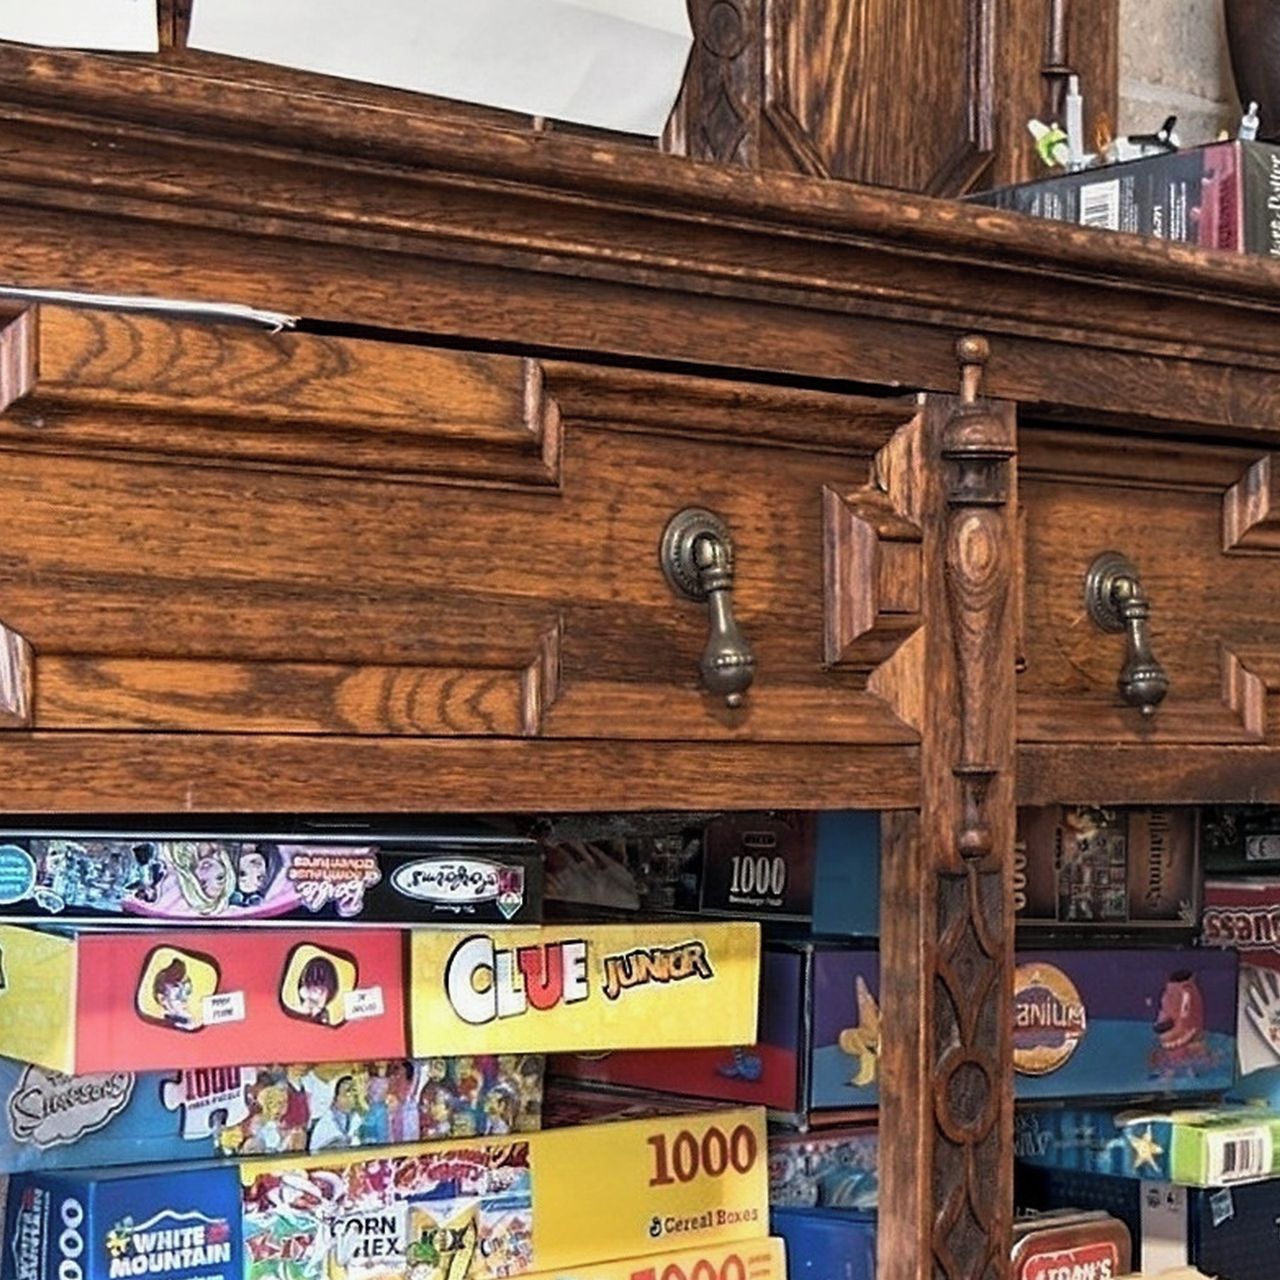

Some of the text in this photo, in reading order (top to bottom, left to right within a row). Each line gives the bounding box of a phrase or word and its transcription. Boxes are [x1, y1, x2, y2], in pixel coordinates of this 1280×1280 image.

[730, 856, 786, 894] 1000
[444, 934, 714, 1026] CLUE JUNIOR
[14, 1073, 126, 1120] Simpsons
[647, 1124, 757, 1187] 1000
[330, 1214, 397, 1239] CORN
[664, 1207, 759, 1234] Cereal Boxes
[131, 1229, 205, 1253] WHITE
[109, 1242, 230, 1280] MOUNTAIN
